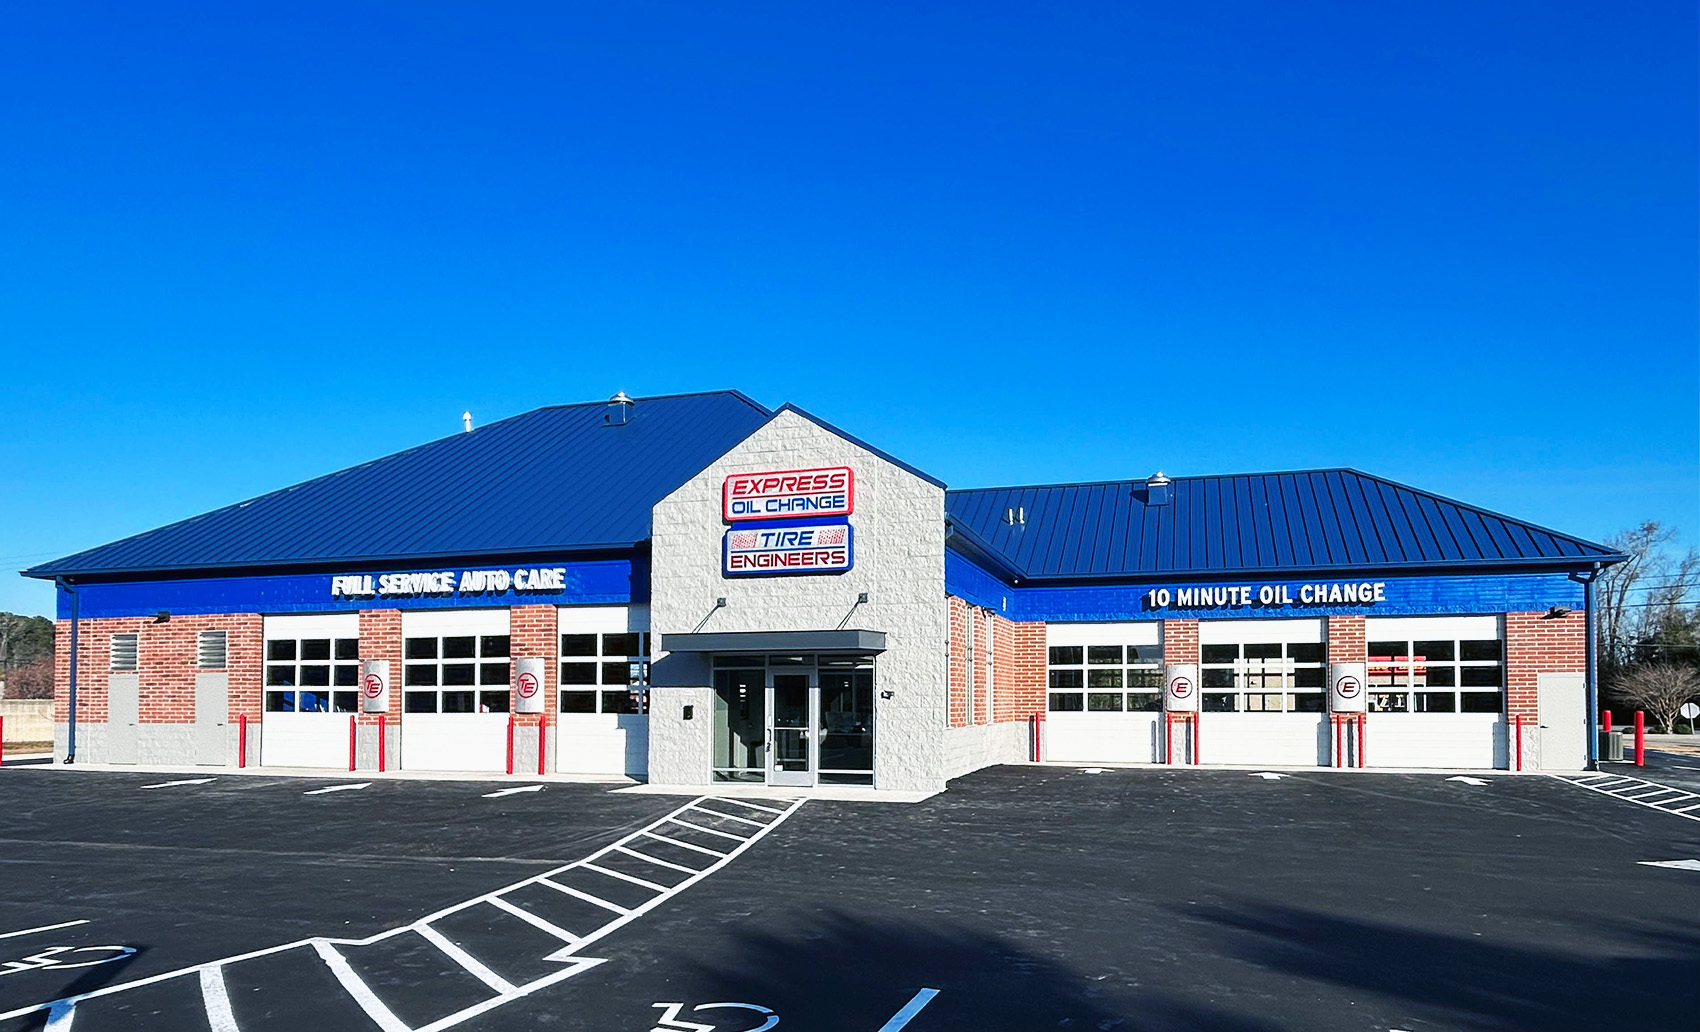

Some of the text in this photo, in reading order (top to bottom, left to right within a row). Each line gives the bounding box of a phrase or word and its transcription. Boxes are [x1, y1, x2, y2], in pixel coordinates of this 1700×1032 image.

[732, 473, 846, 495] EXPRESS
[732, 495, 845, 514] OIL CHANGE
[761, 530, 815, 547] TIRE
[730, 550, 845, 569] ENGINEERS
[331, 568, 567, 596] FULL SERVICE AUTO CARE
[1148, 582, 1386, 607] 10 MINUTE OIL CHANGE
[365, 679, 380, 693] TE
[519, 678, 535, 693] TE
[1175, 682, 1188, 693] E
[1342, 681, 1357, 692] E
